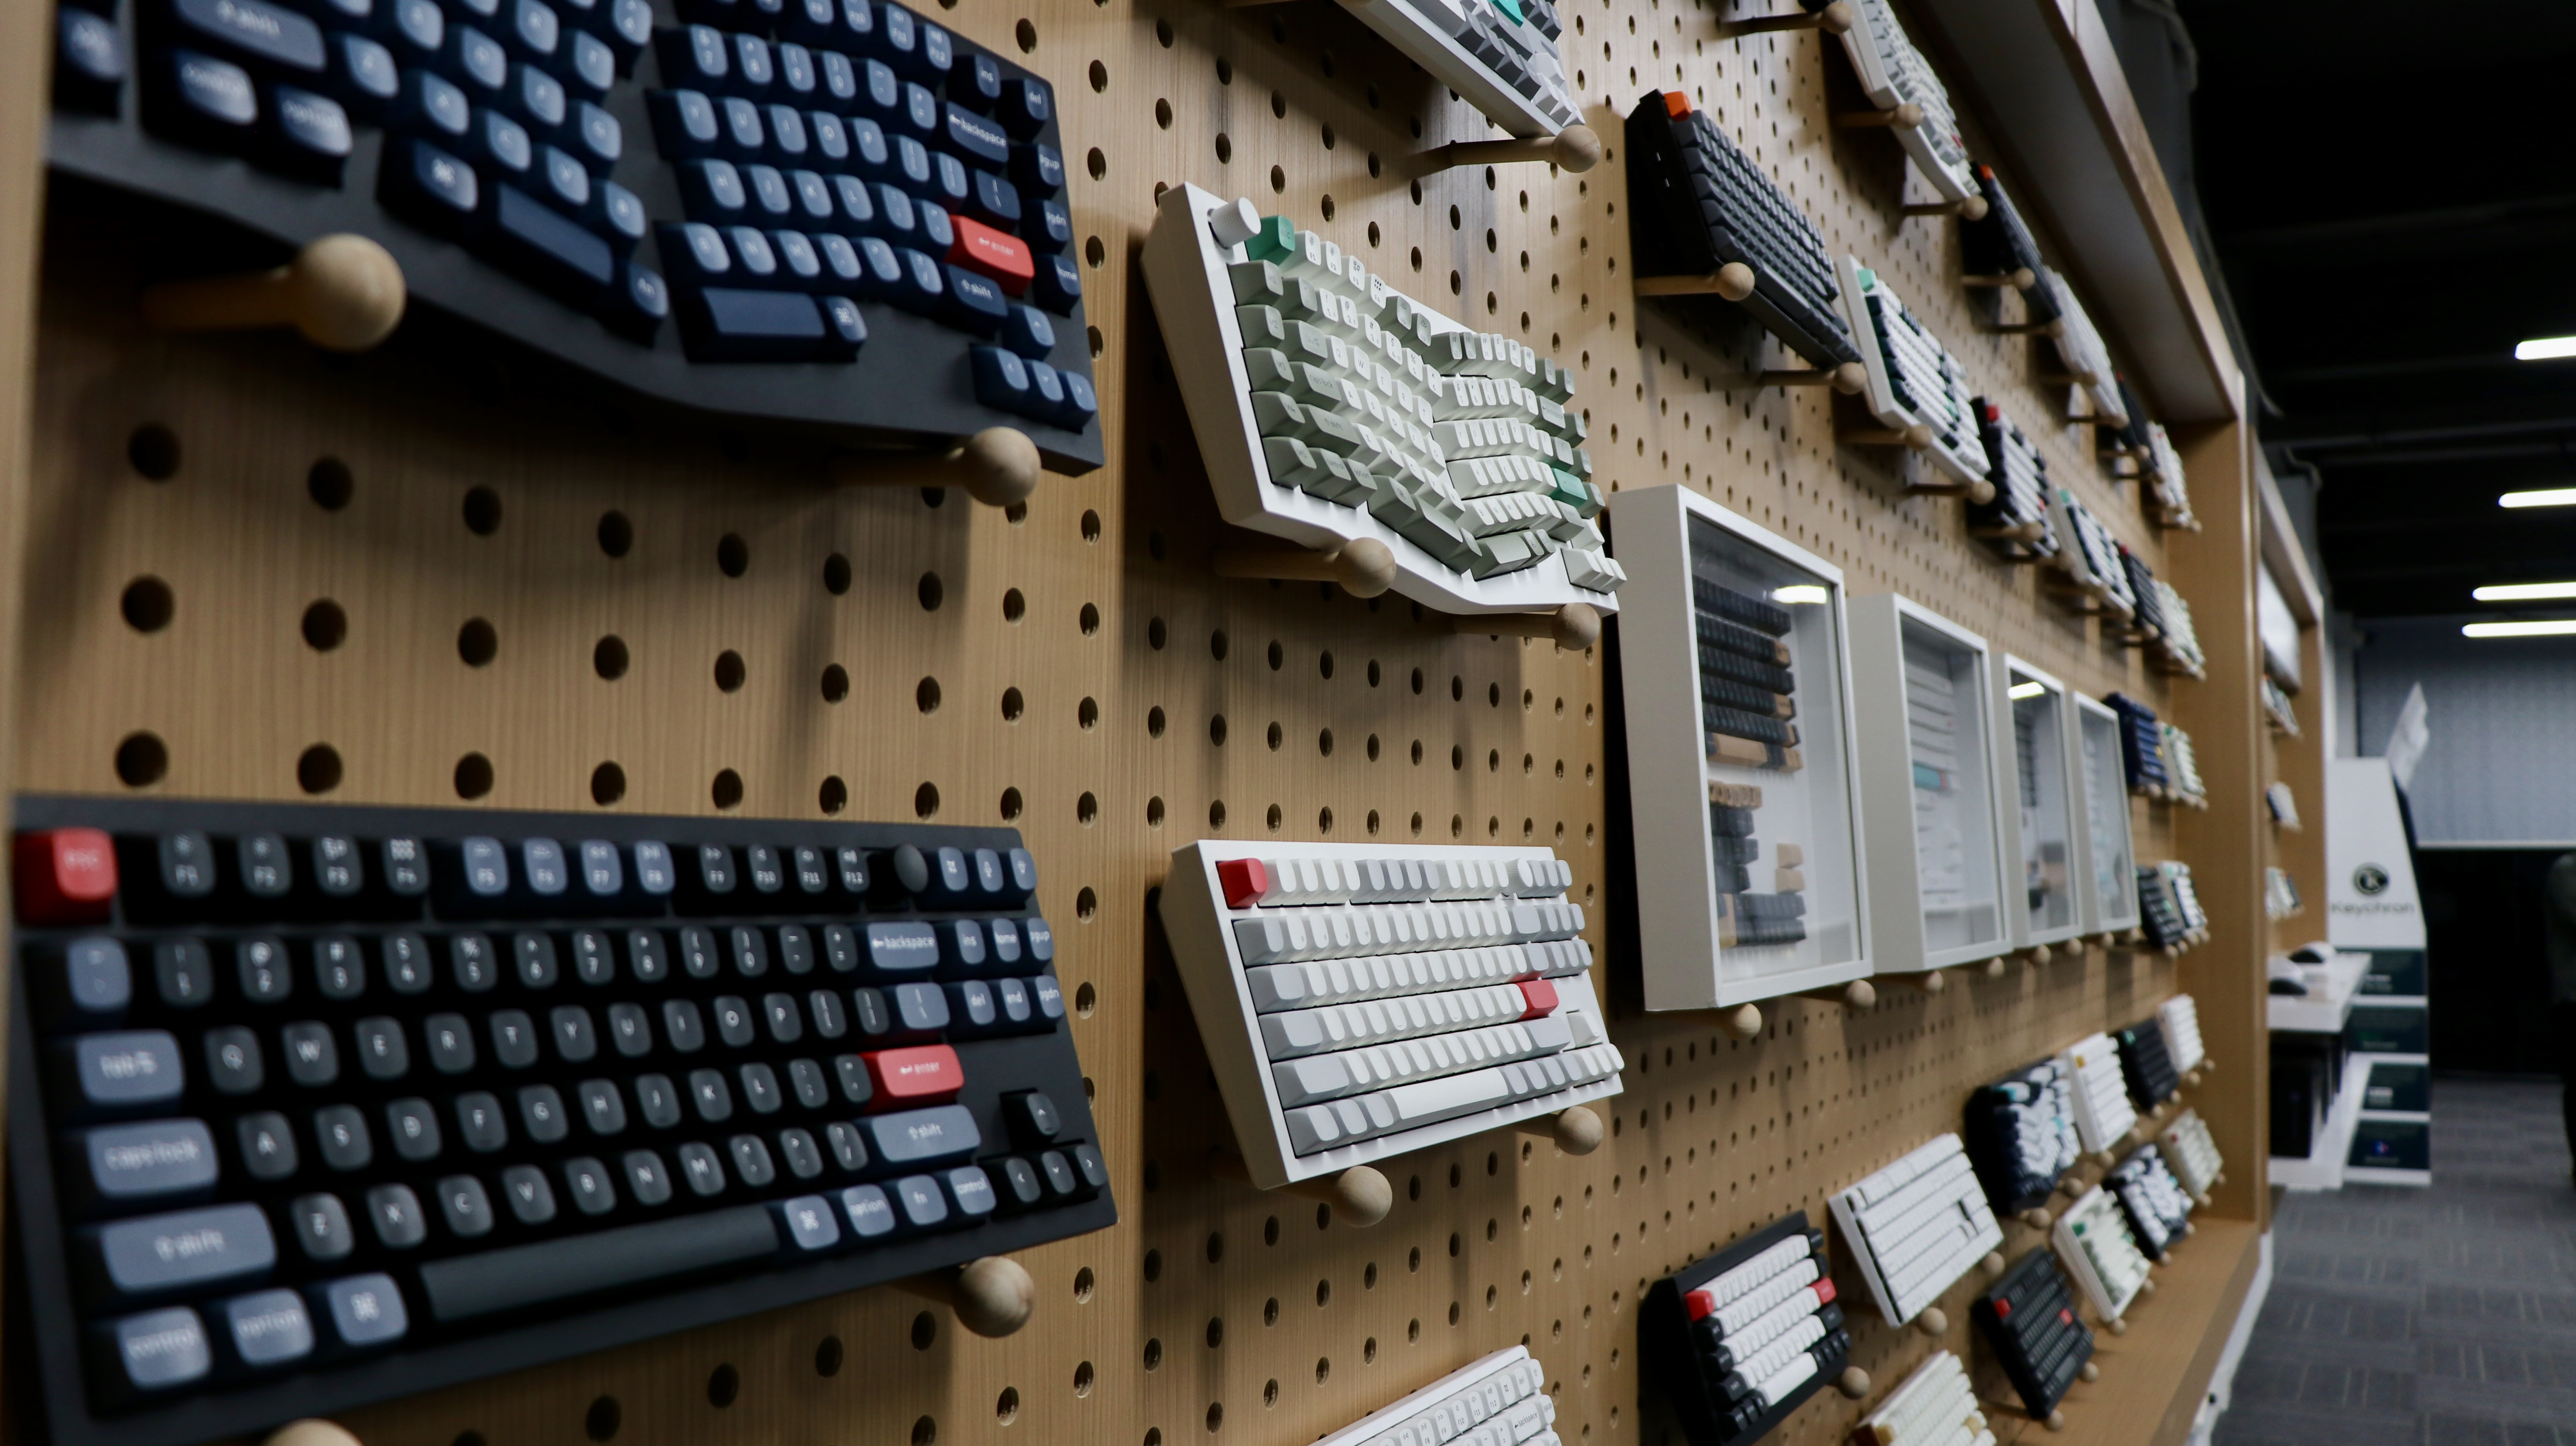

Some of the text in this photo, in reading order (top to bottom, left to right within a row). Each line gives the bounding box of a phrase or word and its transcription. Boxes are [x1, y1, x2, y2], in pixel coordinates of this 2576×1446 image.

[981, 67, 993, 82] ins
[961, 118, 1006, 147] backspace
[991, 243, 1015, 256] enter
[1310, 253, 1316, 261] F1
[1331, 263, 1337, 271] F2
[1353, 276, 1359, 286] F3
[972, 284, 993, 298] shift
[1345, 301, 1350, 311] @
[1375, 295, 1381, 303] F4
[1336, 349, 1342, 358] Q
[1411, 354, 1416, 364] %
[1358, 360, 1364, 368] W
[1309, 374, 1334, 389] capslock
[1402, 393, 1405, 401] R
[1366, 434, 1371, 443] Z
[709, 872, 725, 885] F9
[757, 870, 776, 885] F10
[802, 872, 820, 885] F11
[845, 872, 863, 885] F12
[2330, 900, 2414, 916] Keychron
[885, 936, 935, 949] backspace
[962, 935, 977, 946] ins
[588, 956, 599, 976] 7
[970, 995, 985, 1006] del
[1007, 992, 1022, 1004] end
[564, 1022, 577, 1040] Y
[620, 1018, 635, 1037] U
[440, 1030, 456, 1051] R
[504, 1026, 519, 1045] T
[297, 1039, 320, 1063] W
[372, 1035, 387, 1056] E
[914, 1061, 940, 1074] enter
[702, 1084, 716, 1101] K
[754, 1080, 766, 1094] L
[533, 1102, 550, 1121] G
[592, 1095, 608, 1113] H
[402, 1115, 421, 1138] D
[472, 1109, 486, 1130] F
[334, 1123, 350, 1147] S
[919, 1124, 942, 1138] shift
[257, 1131, 276, 1155] A
[690, 1157, 709, 1174] M
[637, 1166, 654, 1183] N
[517, 1182, 534, 1202] V
[956, 1178, 987, 1194] control
[455, 1193, 470, 1214] C
[914, 1192, 928, 1204] fn
[849, 1199, 886, 1213] option
[384, 1202, 404, 1226] X
[1519, 1412, 1537, 1427] backspace
